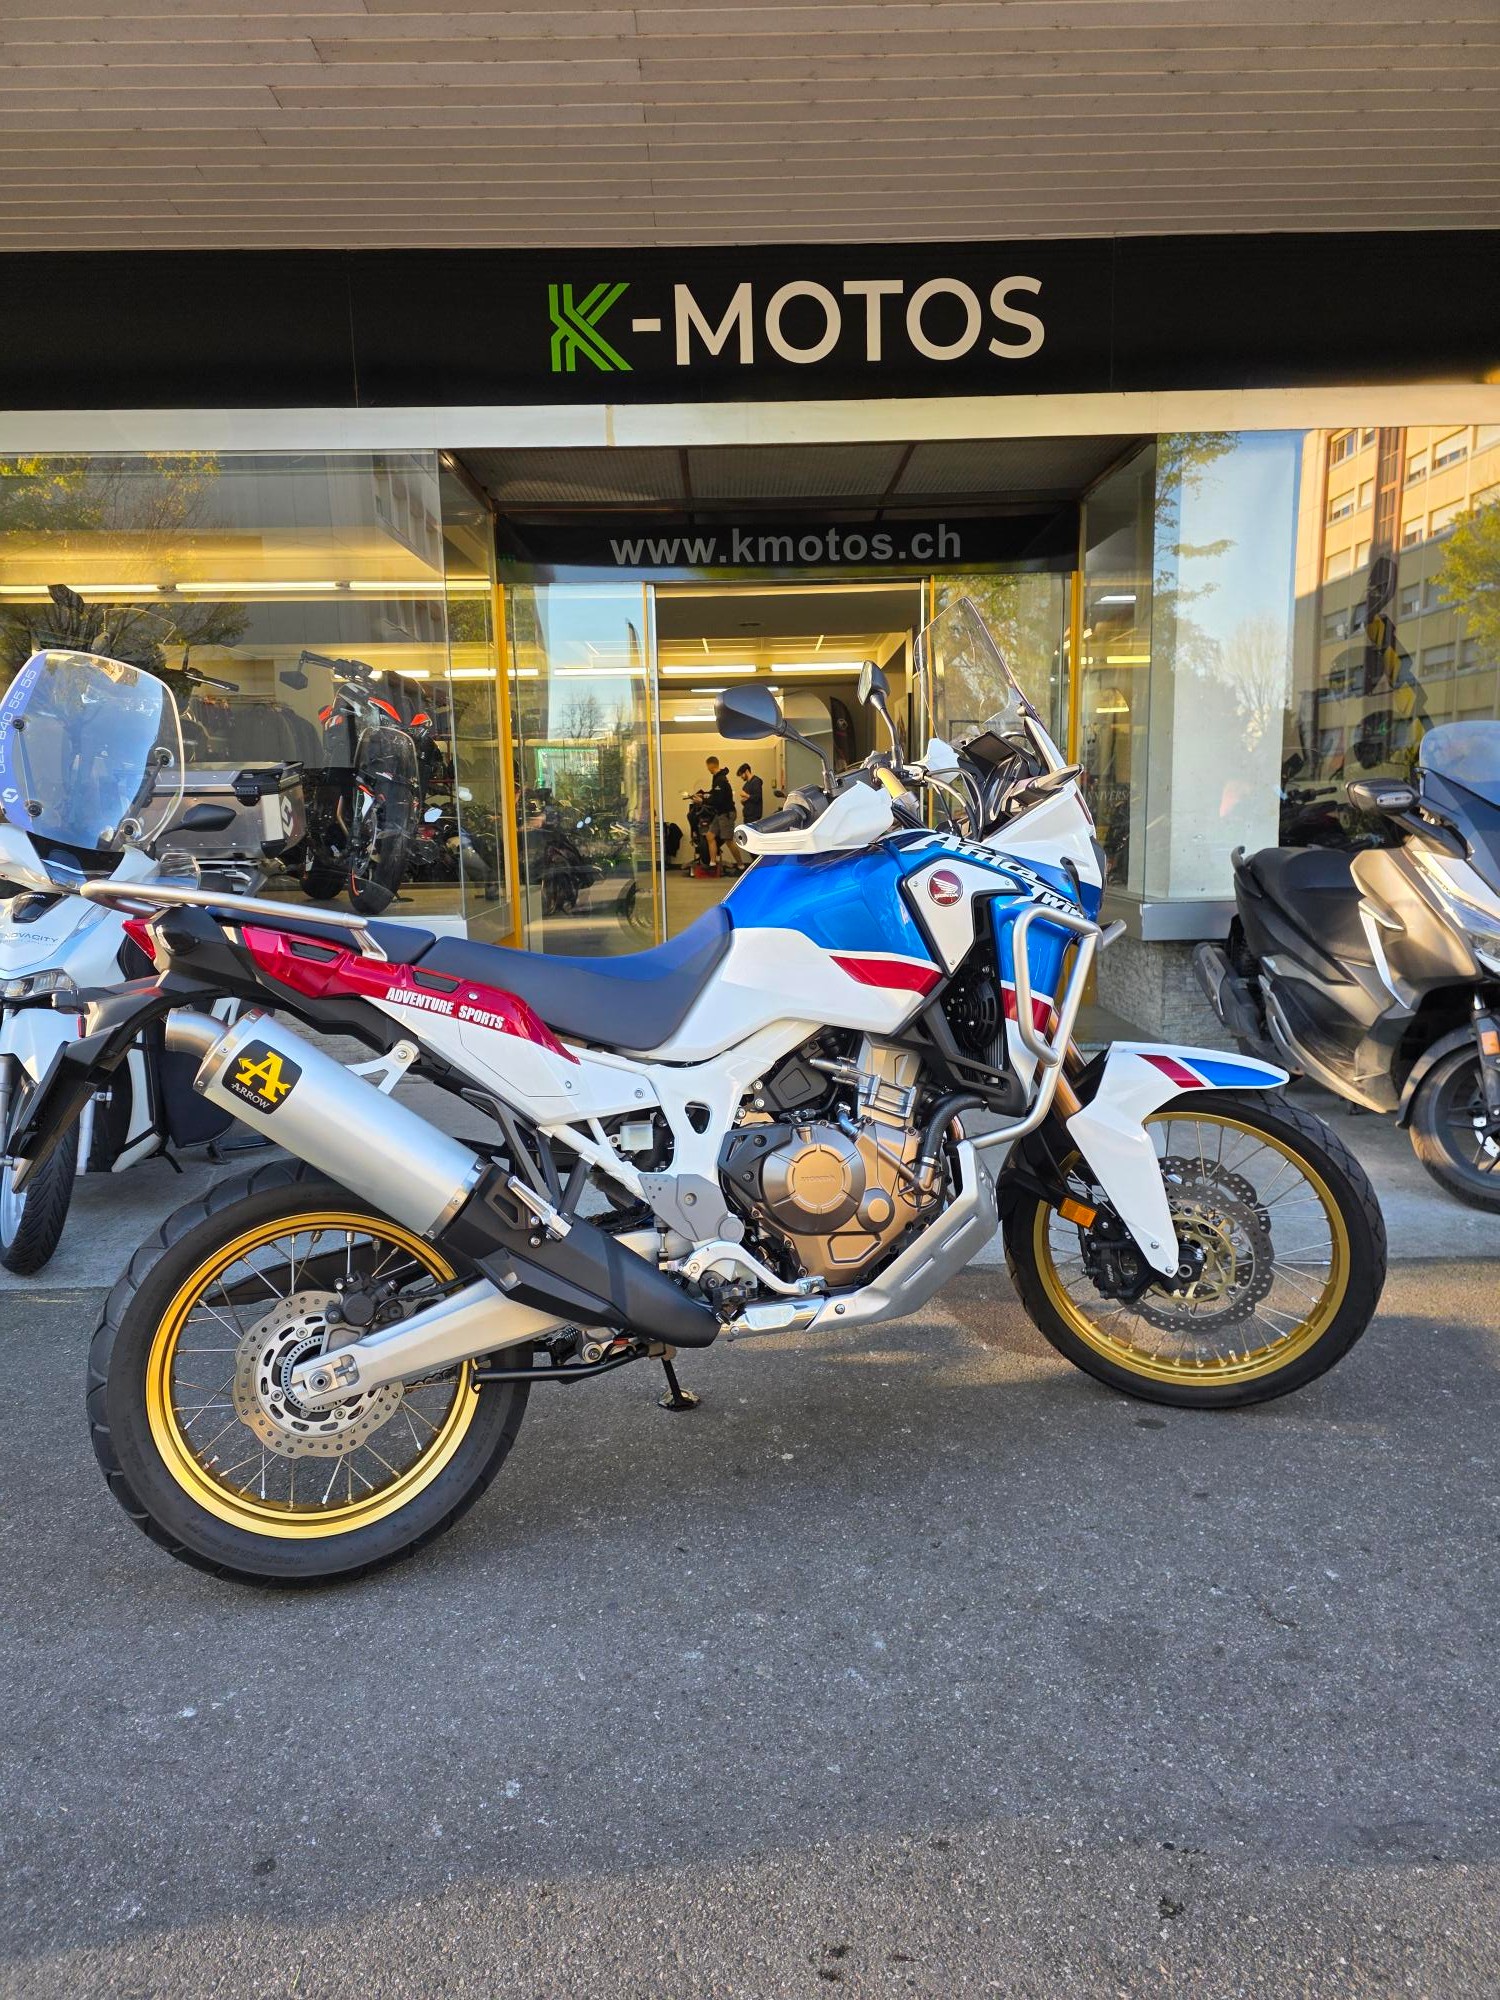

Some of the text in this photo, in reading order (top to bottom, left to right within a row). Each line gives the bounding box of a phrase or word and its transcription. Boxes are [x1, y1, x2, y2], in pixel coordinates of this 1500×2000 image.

[548, 275, 1046, 372] K-MOTOS
[610, 523, 962, 565] www.kmotos.ch
[900, 833, 1039, 880] Africa
[386, 987, 505, 1029] ADVENTURE SPORTS
[231, 1082, 271, 1109] ARROW
